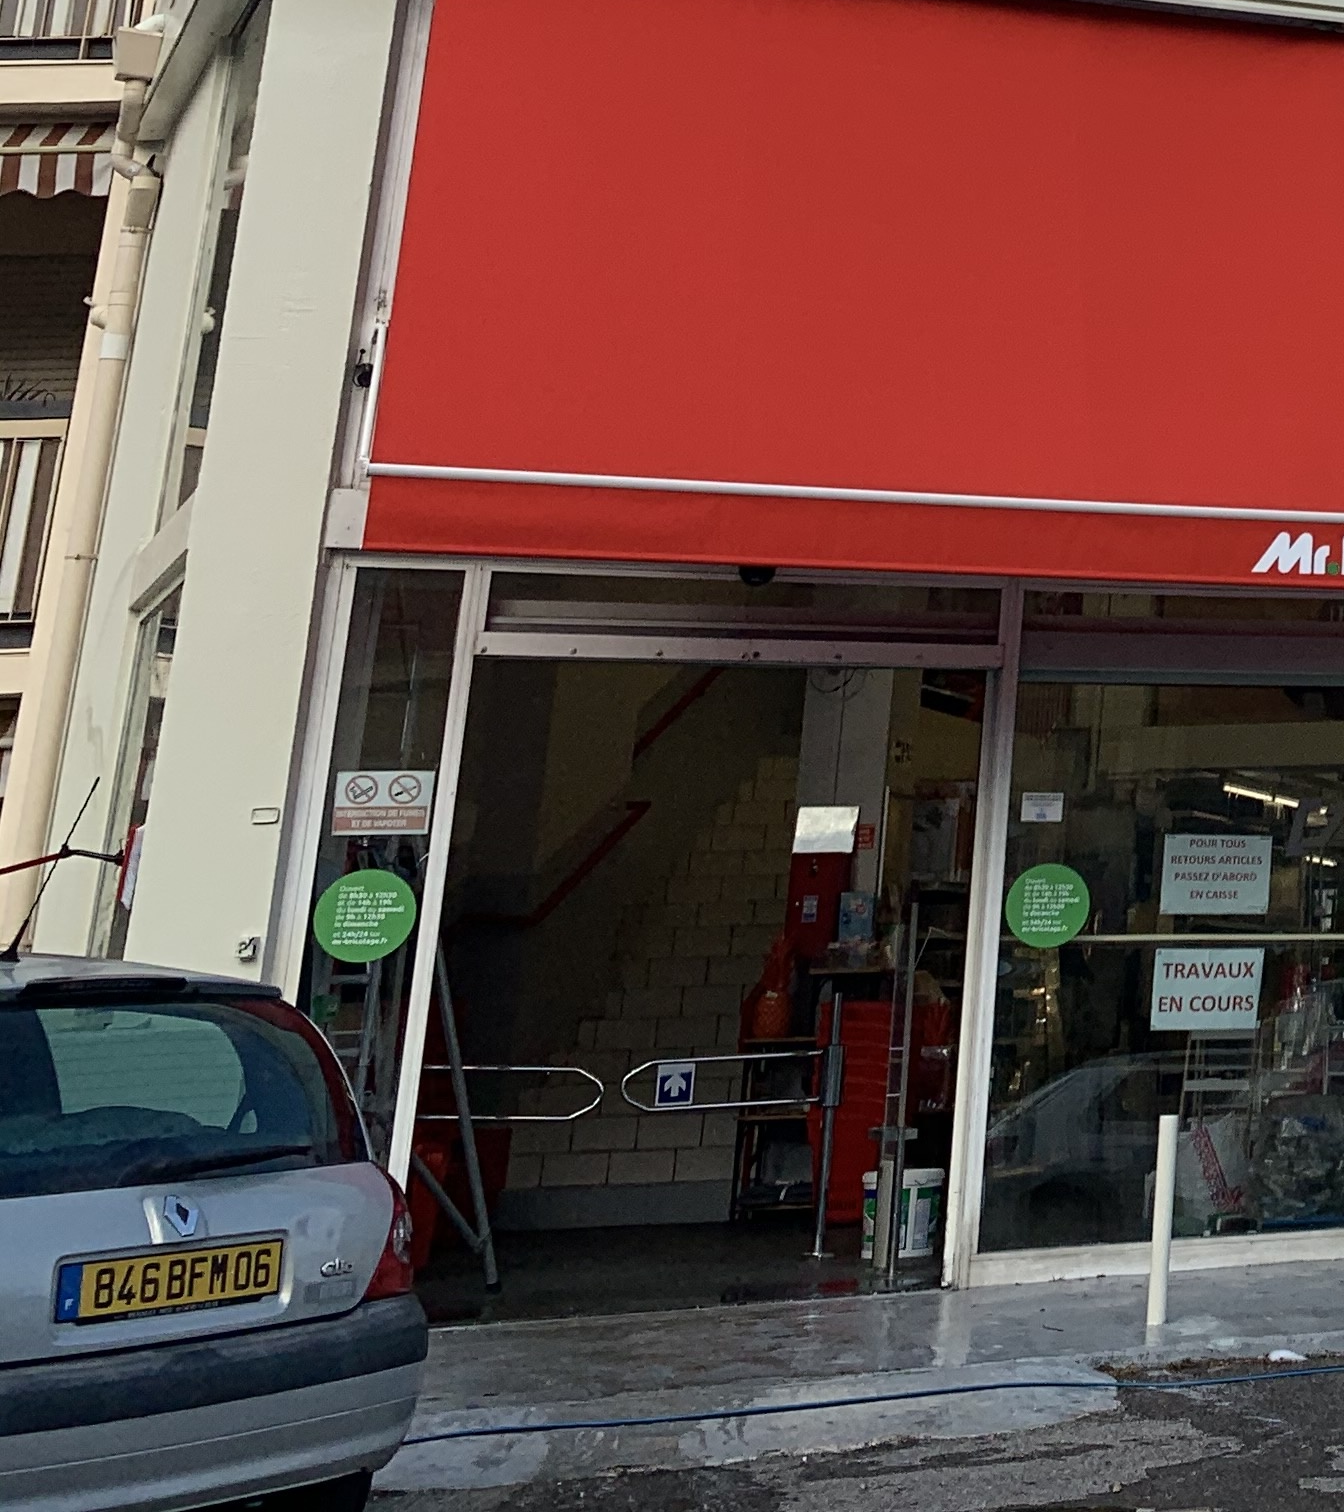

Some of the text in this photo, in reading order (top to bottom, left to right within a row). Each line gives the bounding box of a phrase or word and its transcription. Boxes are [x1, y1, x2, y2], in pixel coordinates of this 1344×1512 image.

[1189, 839, 1247, 849] POUR TOUS
[1170, 855, 1263, 866] RETOURS ARTICLES
[1174, 872, 1210, 882] PASSEZ
[1189, 890, 1239, 900] EN CAISSE
[1163, 962, 1255, 979] TRAVAUX
[1158, 995, 1254, 1013] EN COURS
